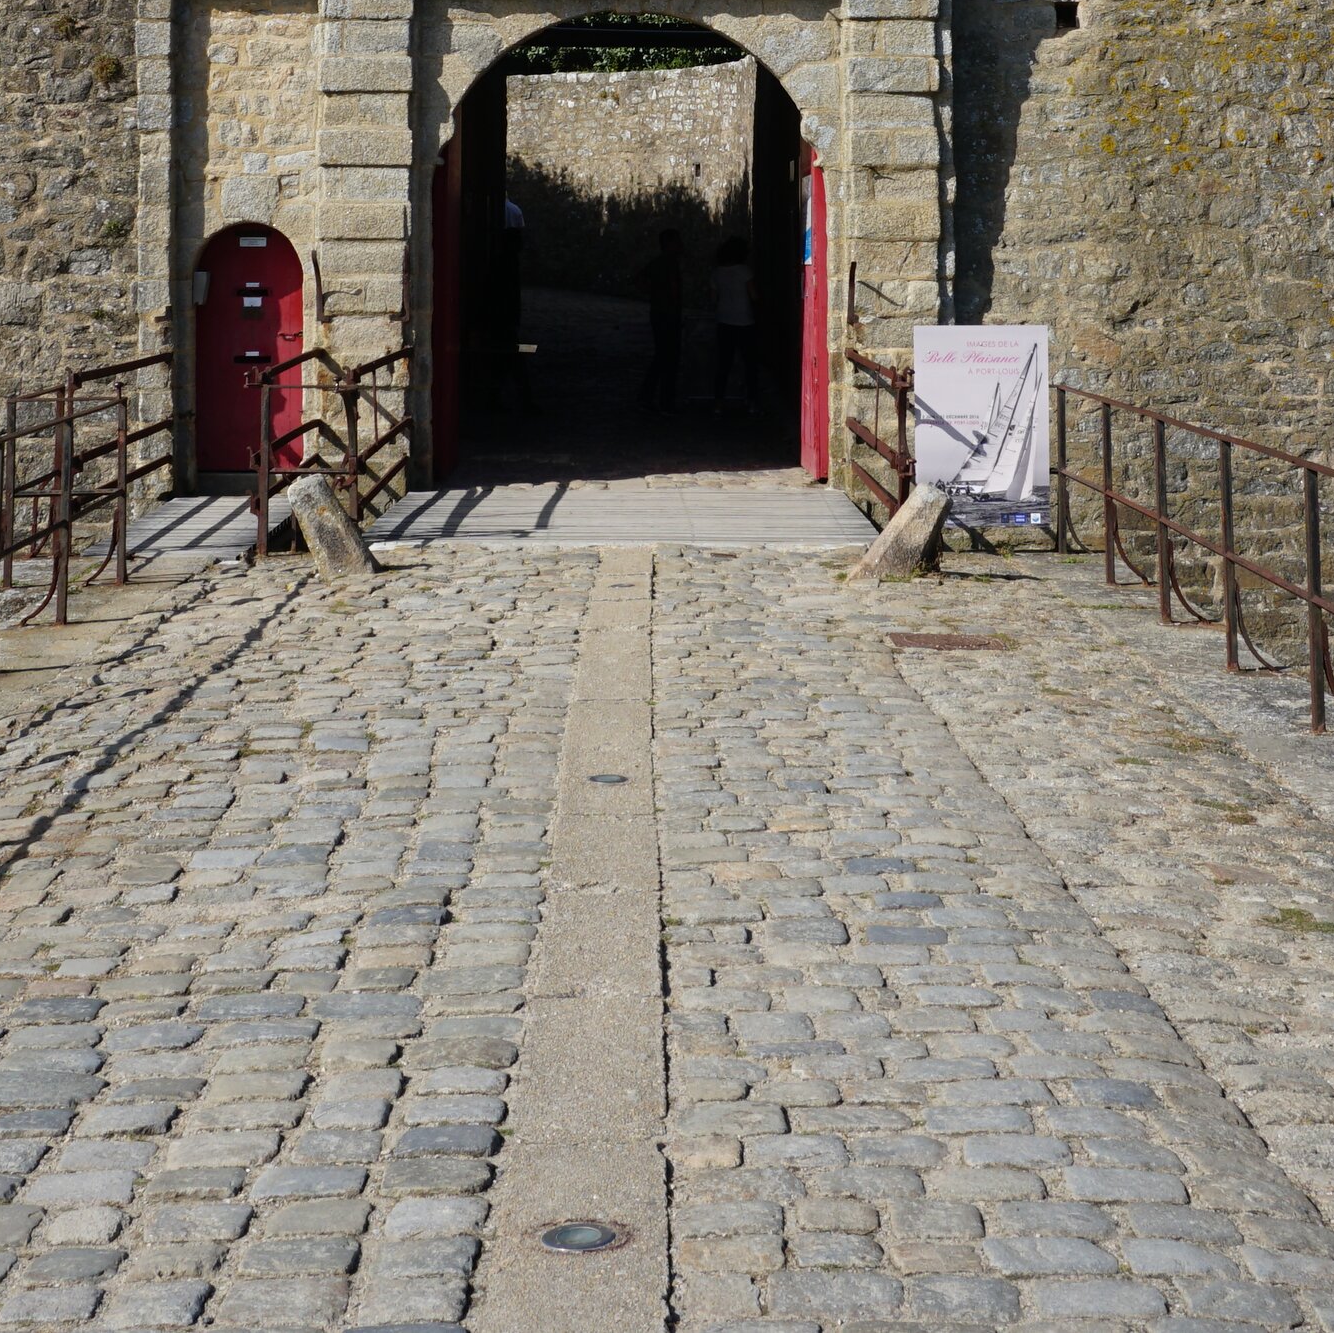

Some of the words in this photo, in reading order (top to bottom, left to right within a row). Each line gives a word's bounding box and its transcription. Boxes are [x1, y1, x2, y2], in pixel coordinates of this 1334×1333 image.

[966, 340, 996, 348] IMAGES
[998, 340, 1008, 348] DE
[1009, 340, 1019, 348] LA
[922, 349, 957, 364] Belle
[961, 349, 1020, 364] Plaisance
[975, 367, 1020, 376] PORT-LOUIS
